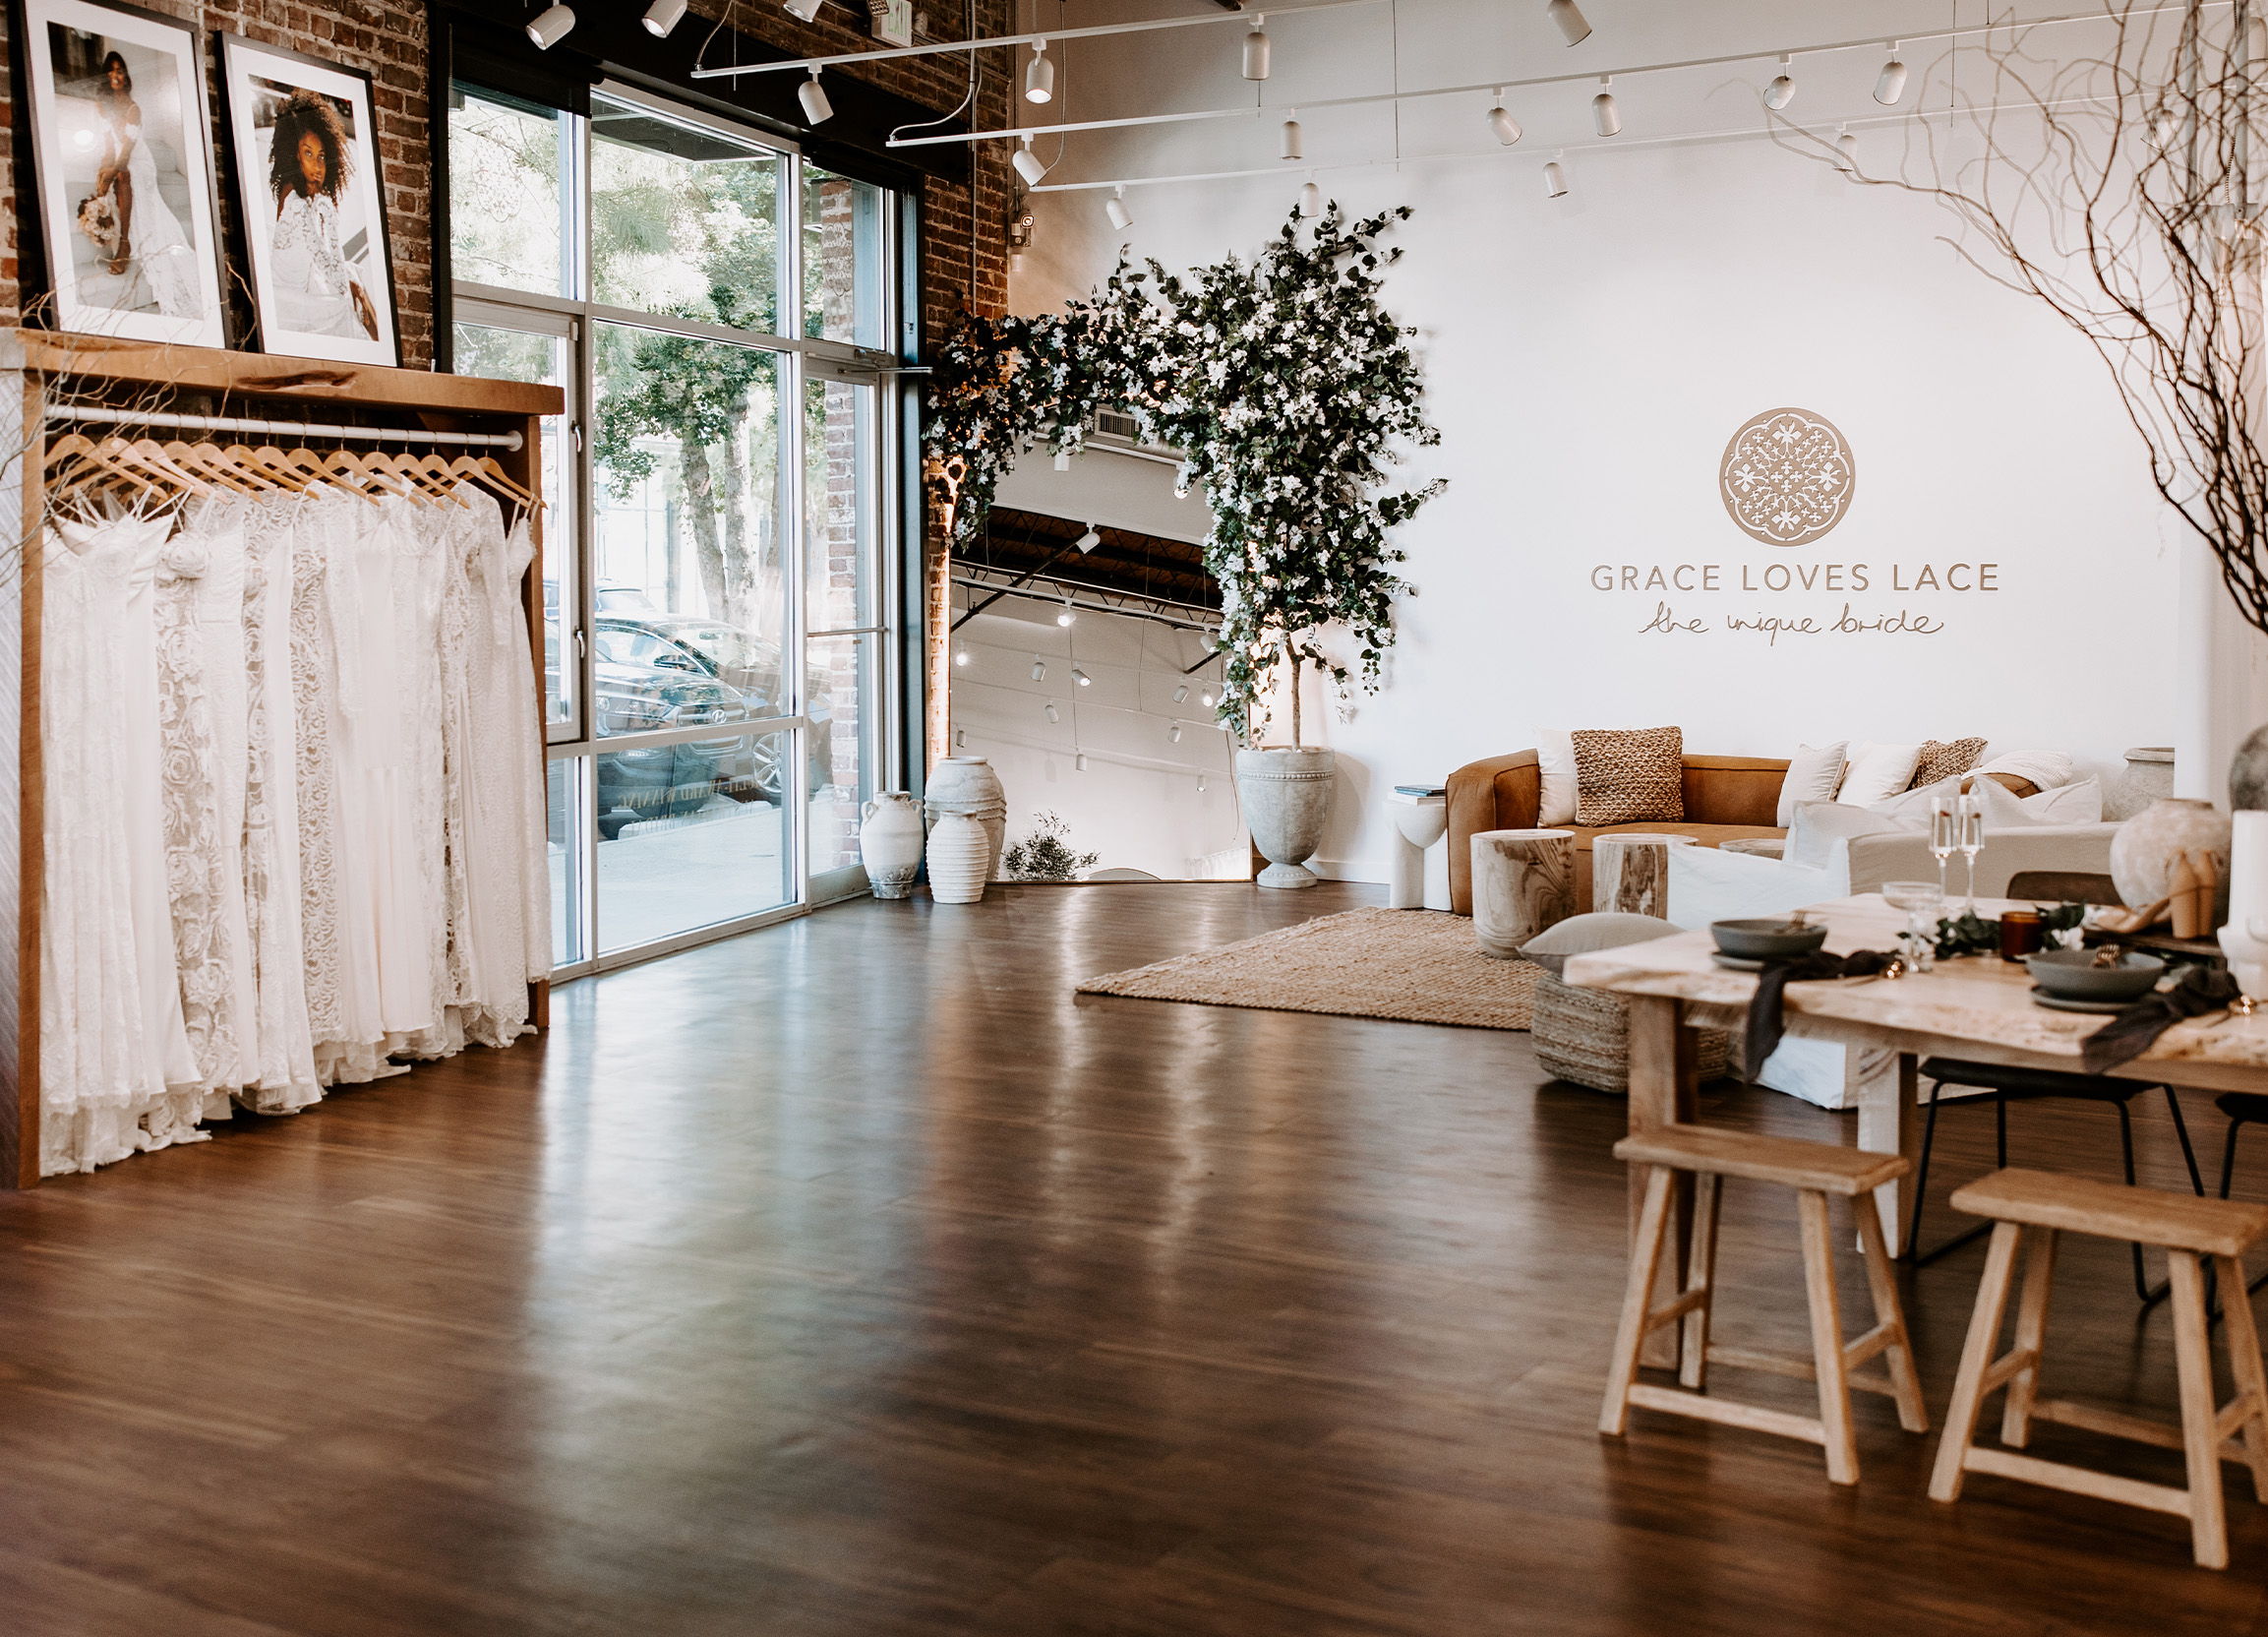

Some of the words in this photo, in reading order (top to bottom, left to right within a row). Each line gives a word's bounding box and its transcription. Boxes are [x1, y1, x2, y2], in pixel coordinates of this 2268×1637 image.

[887, 0, 909, 37] EXIT
[1590, 564, 1720, 592] GRACE
[1742, 563, 1870, 592] LOVES
[1893, 563, 1999, 592] LACE
[1638, 600, 1710, 635] the
[1727, 611, 1822, 646] unique
[1829, 601, 1944, 635] bride
